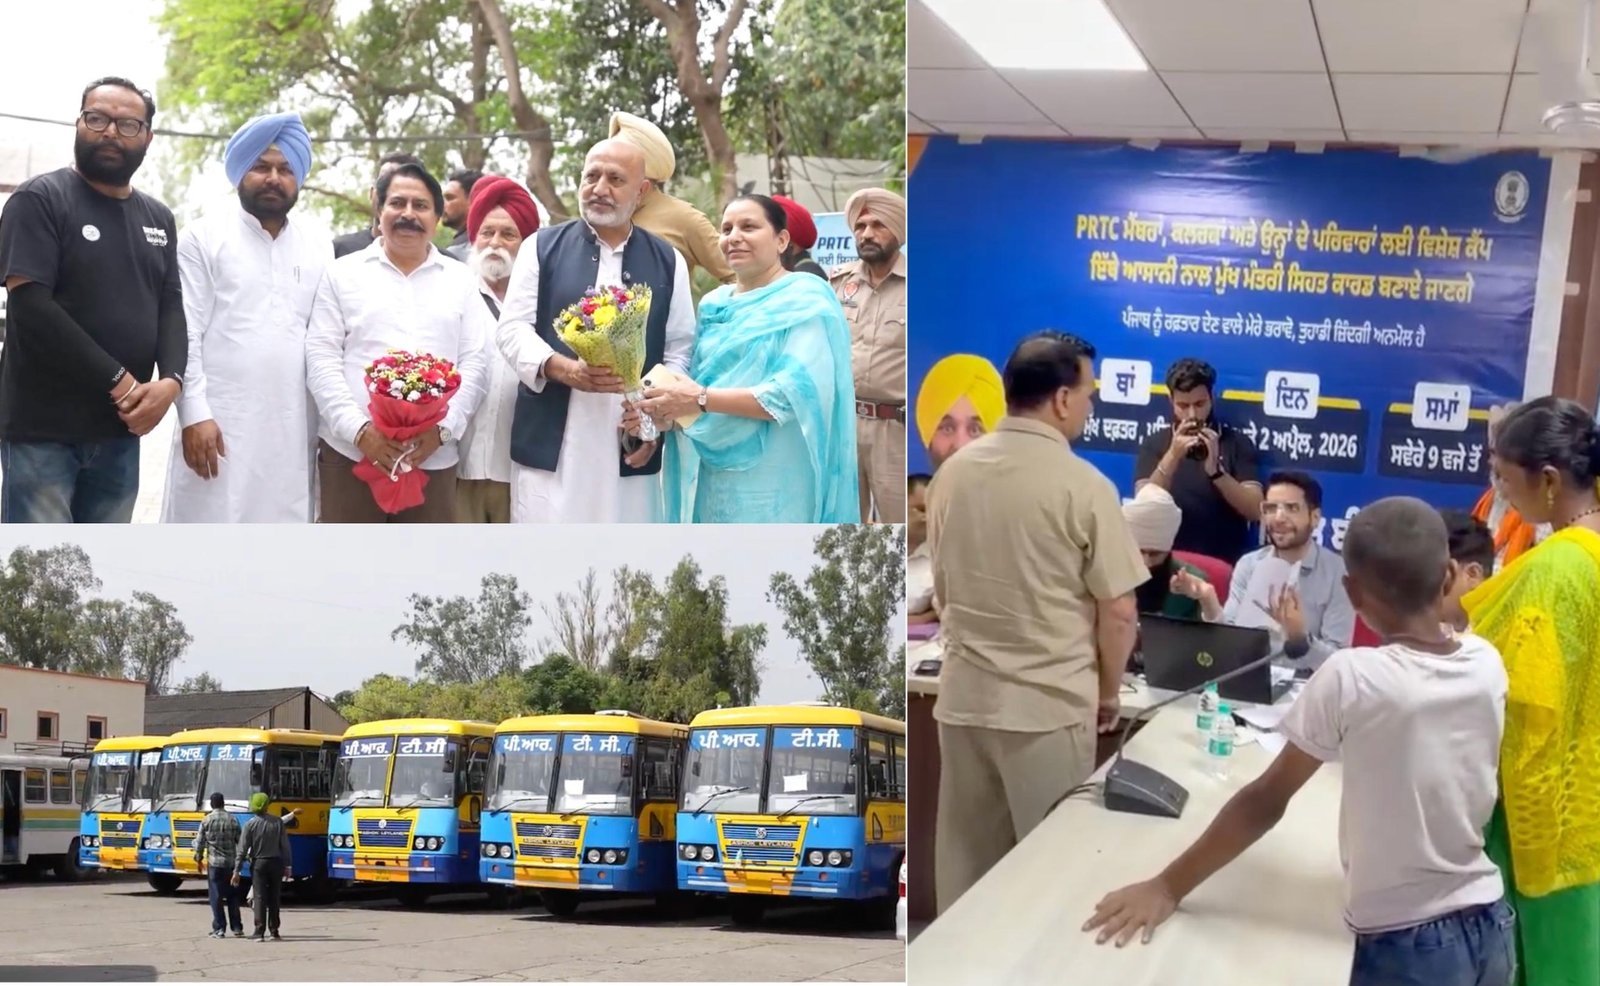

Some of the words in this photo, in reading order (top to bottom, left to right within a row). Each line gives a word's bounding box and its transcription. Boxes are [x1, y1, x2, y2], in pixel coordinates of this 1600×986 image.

[817, 236, 852, 250] PRTC
[1076, 214, 1120, 240] PRTC
[1229, 217, 1257, 247] ਅਤੇ
[1295, 219, 1310, 251] ਦੇ
[1313, 219, 1377, 254] ਪਰਿਵਾਰਾਂ
[1380, 223, 1414, 257] ਲਈ
[1122, 252, 1178, 285] ਆਸਾਨੀ
[1180, 264, 1212, 287] ਨਾਲ
[1243, 260, 1285, 293] ਮੰਤਰੀ
[1287, 260, 1329, 294] ਸਿਹਤ
[1331, 271, 1375, 297] ਕਾਰਡ
[1378, 267, 1423, 300] ਬਣਾਏ
[1424, 271, 1475, 304] ਜਾਣਗੇ
[1122, 305, 1151, 330] ਪੰਜਾਬ
[1152, 306, 1164, 337] ਨੂੰ
[1202, 309, 1221, 334] ਦੇਣ
[1221, 312, 1244, 336] ਵਾਲੇ
[1244, 312, 1263, 337] ਮੇਰੇ
[1298, 318, 1332, 345] ਤੁਹਾਡੀ
[1373, 322, 1413, 347] ਅਨਮੋਲ
[1414, 324, 1426, 348] ਹੈ
[1276, 377, 1310, 411] ਦਿਨ
[1425, 391, 1460, 422] ਸਮਾਂ
[1258, 427, 1269, 450] 2
[1318, 432, 1358, 459] 2026
[1390, 438, 1426, 467] ਸਵੇਰੇ
[1428, 448, 1439, 470] 9
[1442, 442, 1466, 471] ਵਜੇ
[1467, 444, 1483, 472] ਤੋਂ
